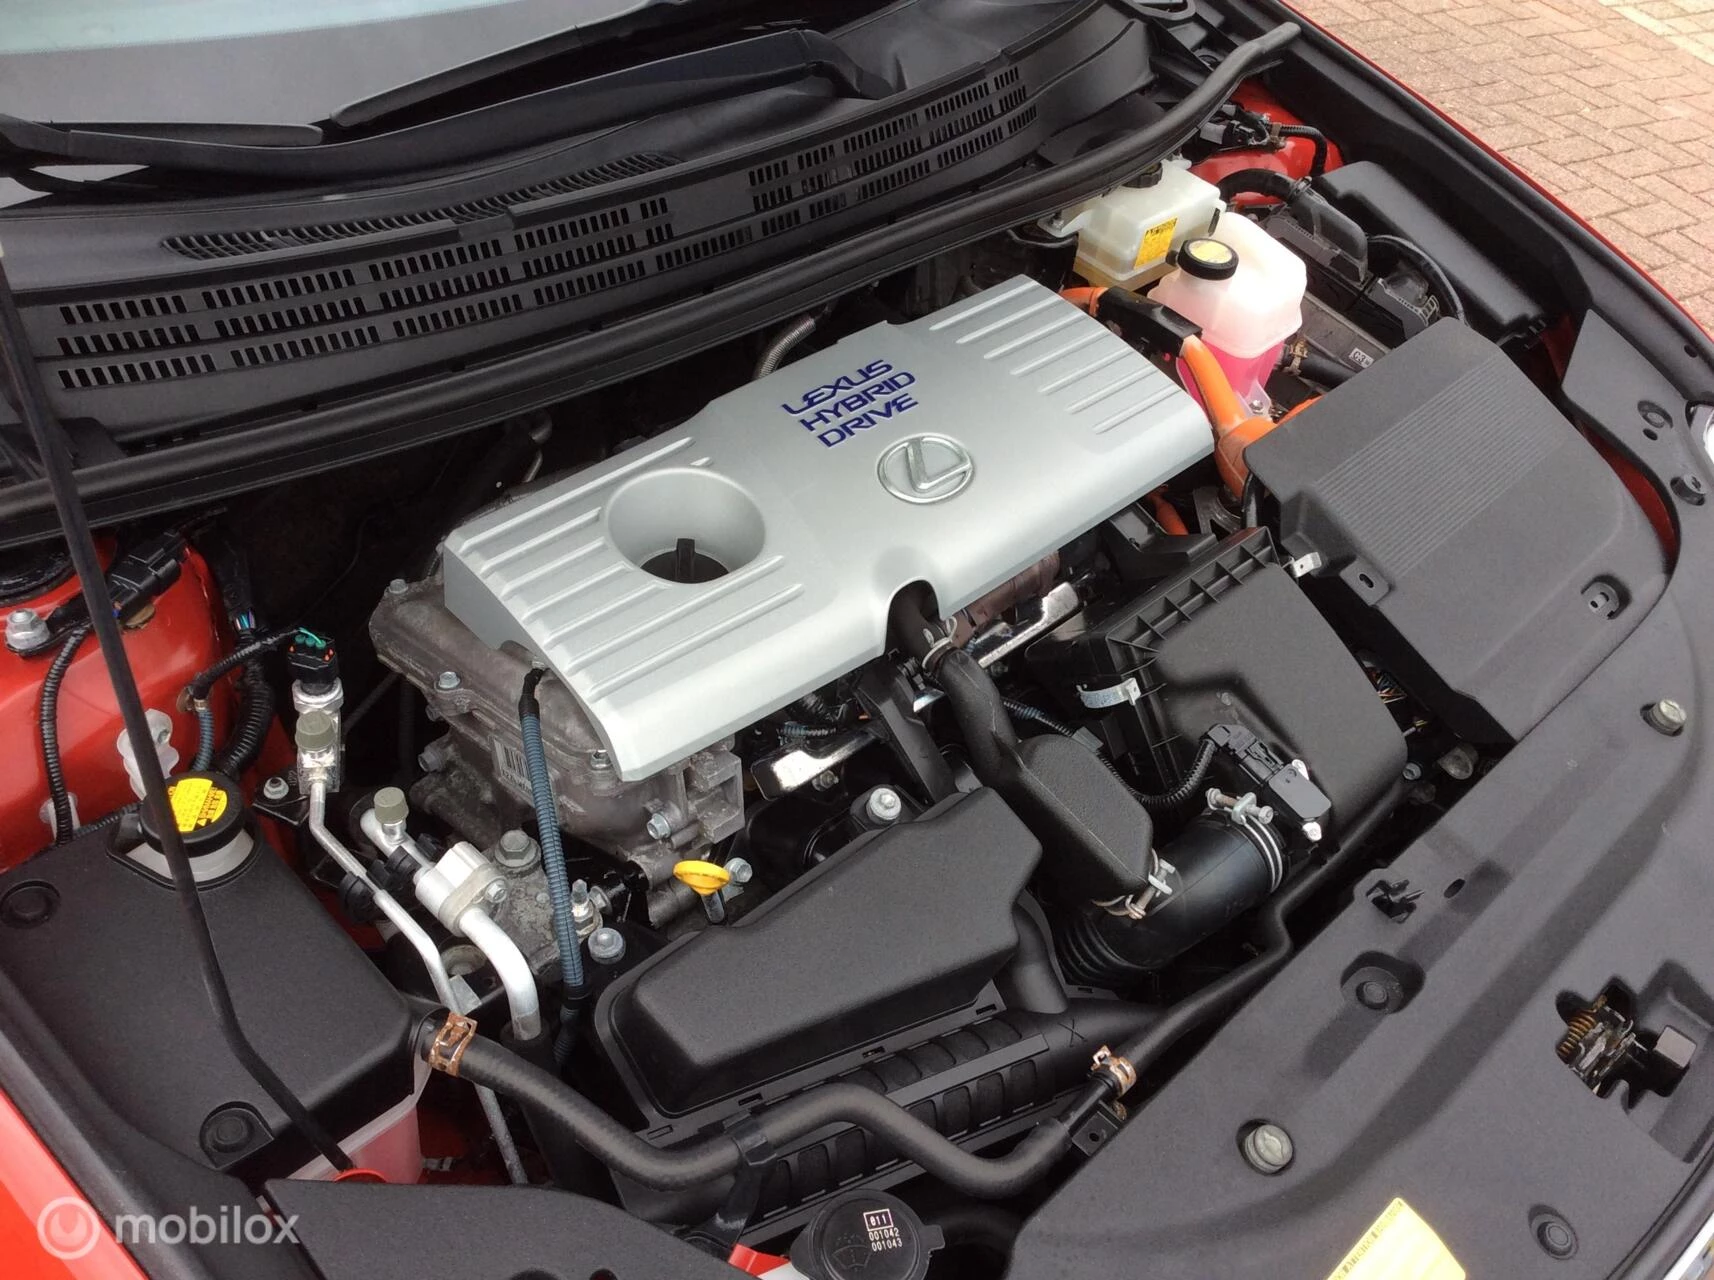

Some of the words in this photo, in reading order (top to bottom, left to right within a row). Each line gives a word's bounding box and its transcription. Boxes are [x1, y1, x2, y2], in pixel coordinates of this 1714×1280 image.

[781, 359, 894, 415] LEXUS
[799, 371, 916, 431] HYBRID
[817, 393, 919, 447] DRIVE
[869, 1227, 900, 1241] 001042
[872, 1237, 903, 1251] 001043
